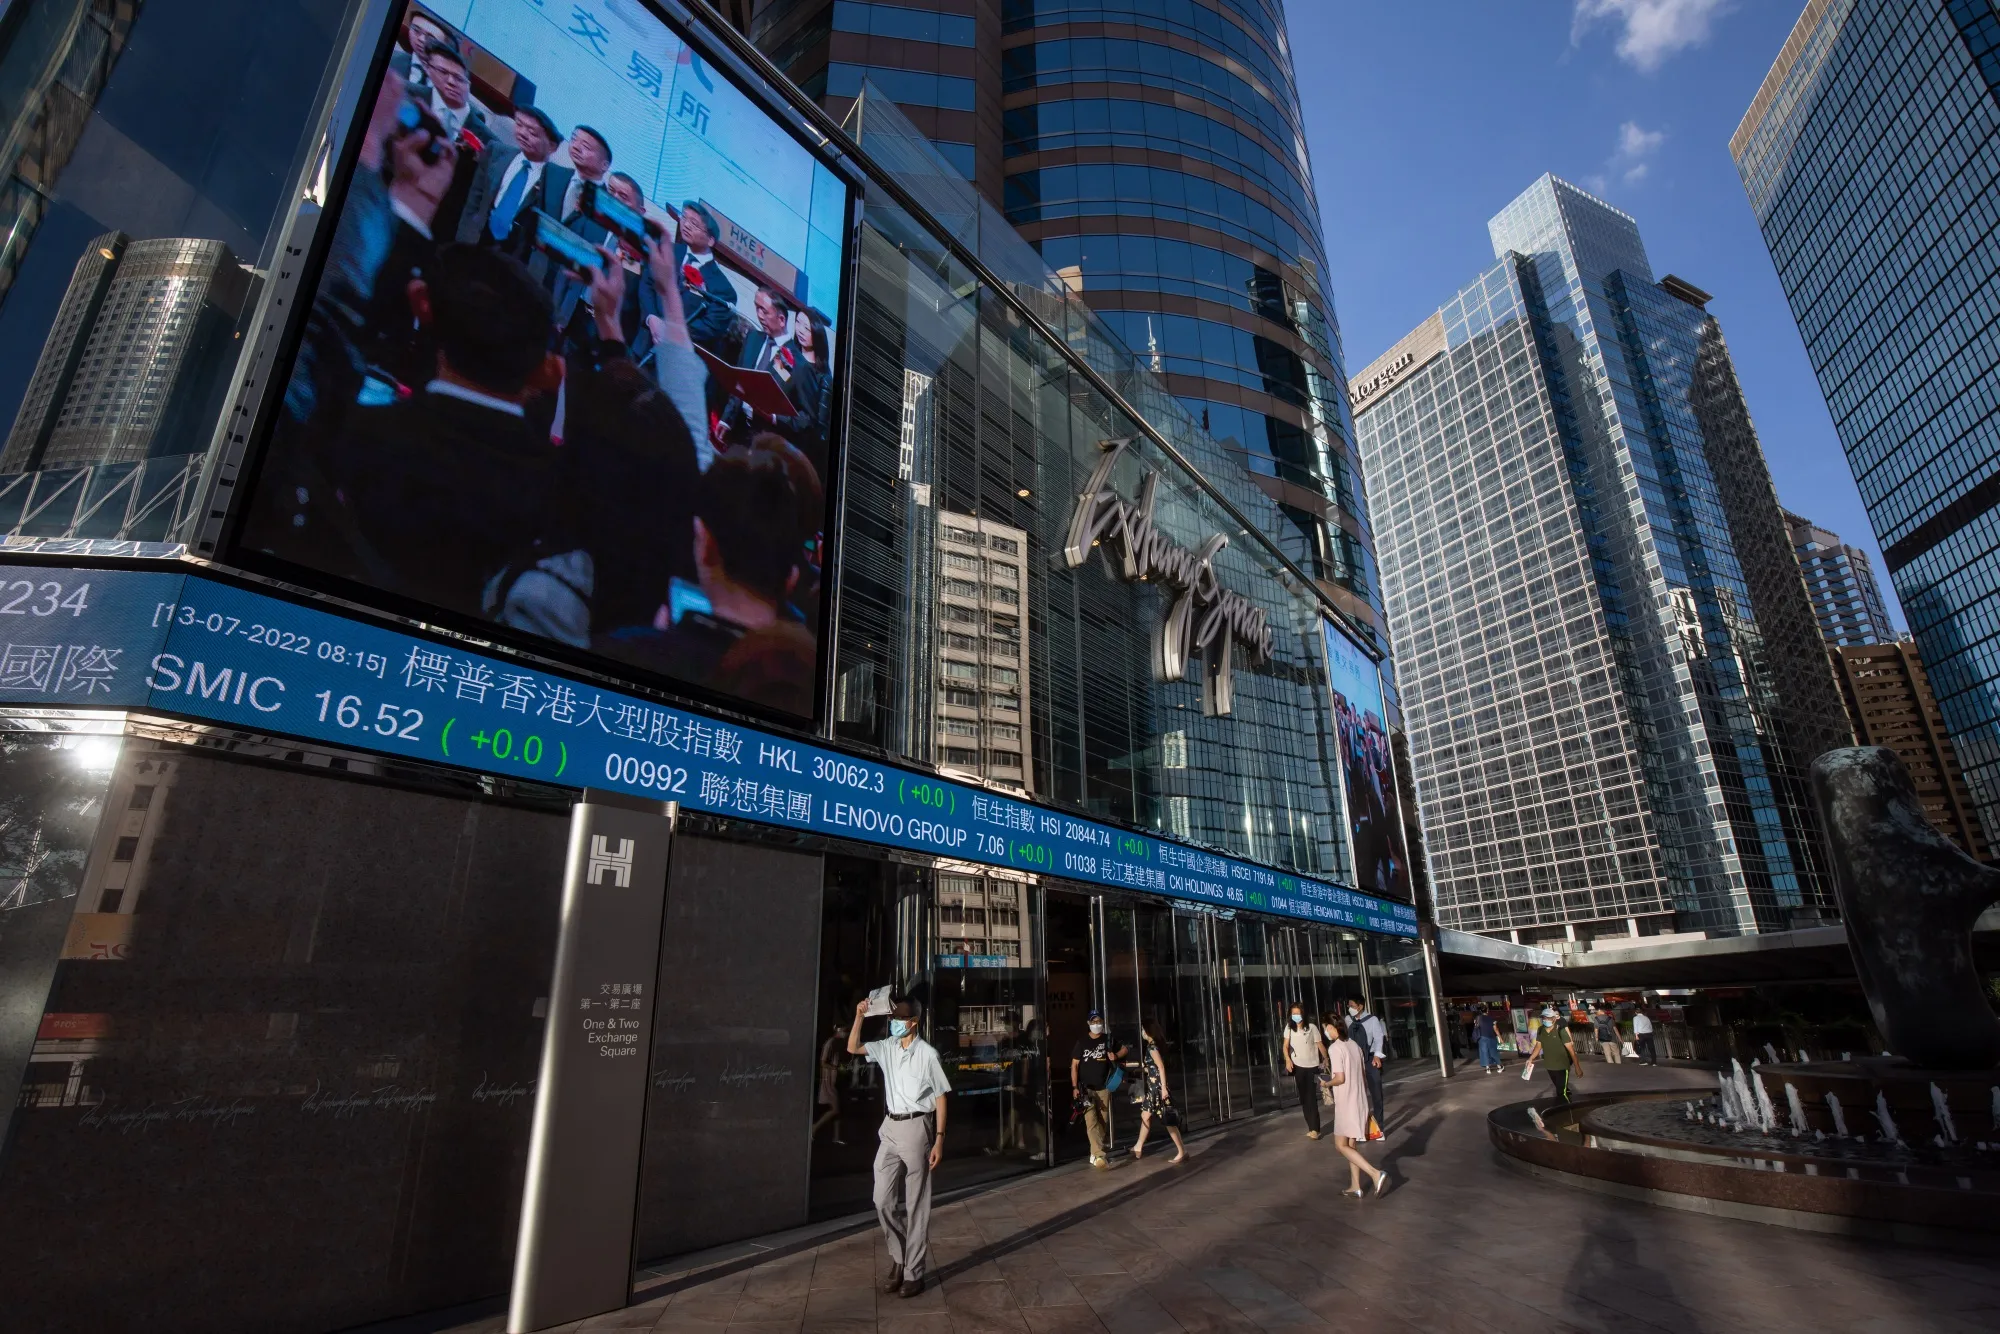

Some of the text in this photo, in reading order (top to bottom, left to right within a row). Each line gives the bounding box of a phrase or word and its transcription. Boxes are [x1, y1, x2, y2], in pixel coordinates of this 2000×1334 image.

[533, 0, 711, 137] 交易所
[731, 225, 765, 259] HKEX
[0, 579, 91, 617] 234
[151, 602, 311, 655] [13-07-2022
[317, 641, 387, 679] 08:15]
[400, 645, 744, 766] 標普香港大型股指數
[759, 742, 803, 774] HKL
[812, 756, 884, 794] 30062.3
[972, 795, 1035, 834] 恒生指數
[1041, 815, 1061, 836] HSI
[1065, 821, 1110, 847] 20844.74
[1158, 844, 1229, 879] 恒生中國企業指數
[1231, 864, 1251, 881] HSCEI
[1253, 870, 1275, 886] 7191.64
[0, 643, 123, 695] 國際
[145, 652, 286, 713] SMIC
[314, 690, 424, 742] 16.52
[605, 753, 688, 794] 00992
[699, 770, 813, 824] 聯想集團
[823, 800, 904, 836] LENOVO
[908, 818, 967, 848] GROUP
[976, 832, 1005, 856] 7.06
[1065, 852, 1096, 874] 01038
[1100, 858, 1166, 891] 長江基建集團
[1169, 874, 1184, 891] CKI
[1185, 878, 1224, 899] HOLDINGS
[1226, 886, 1244, 902] 48.65
[583, 1018, 639, 1029] One & Two
[588, 1032, 638, 1045] Exchange
[600, 1046, 637, 1058] Square
